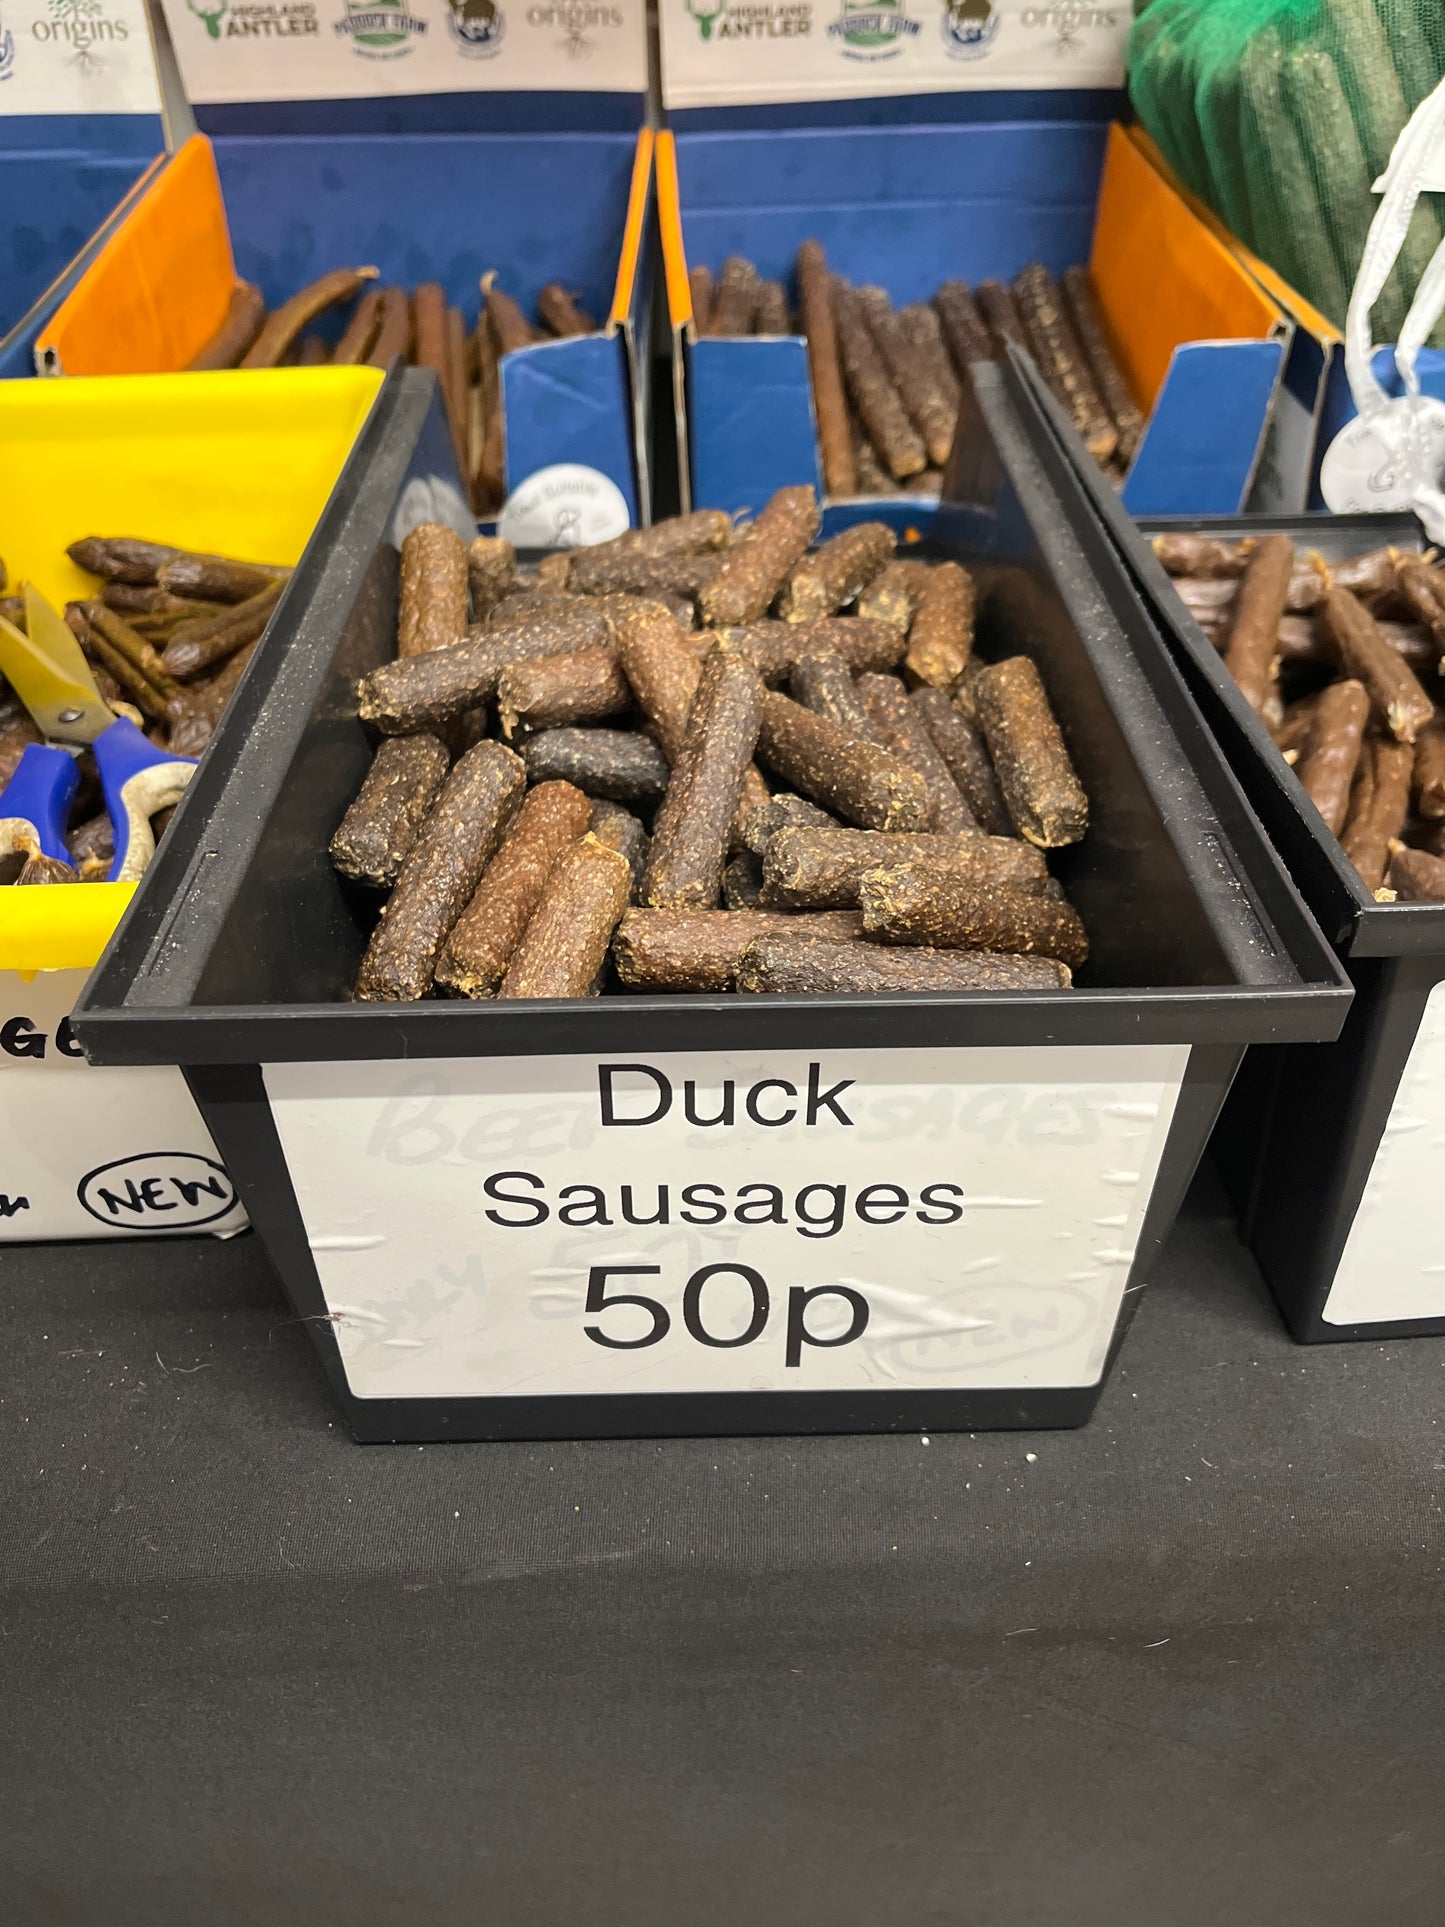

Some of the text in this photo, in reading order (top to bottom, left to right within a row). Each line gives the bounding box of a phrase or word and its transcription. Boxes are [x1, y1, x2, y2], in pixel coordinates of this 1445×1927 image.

[31, 19, 129, 50] origins
[226, 18, 319, 38] ANTLER
[526, 6, 624, 35] origins
[719, 19, 811, 38] ANTLER
[1020, 6, 1117, 35] origins
[598, 1062, 857, 1127] Duck
[97, 1176, 229, 1215] NEW
[484, 1172, 964, 1239] Sausages
[583, 1264, 871, 1368] 50p
